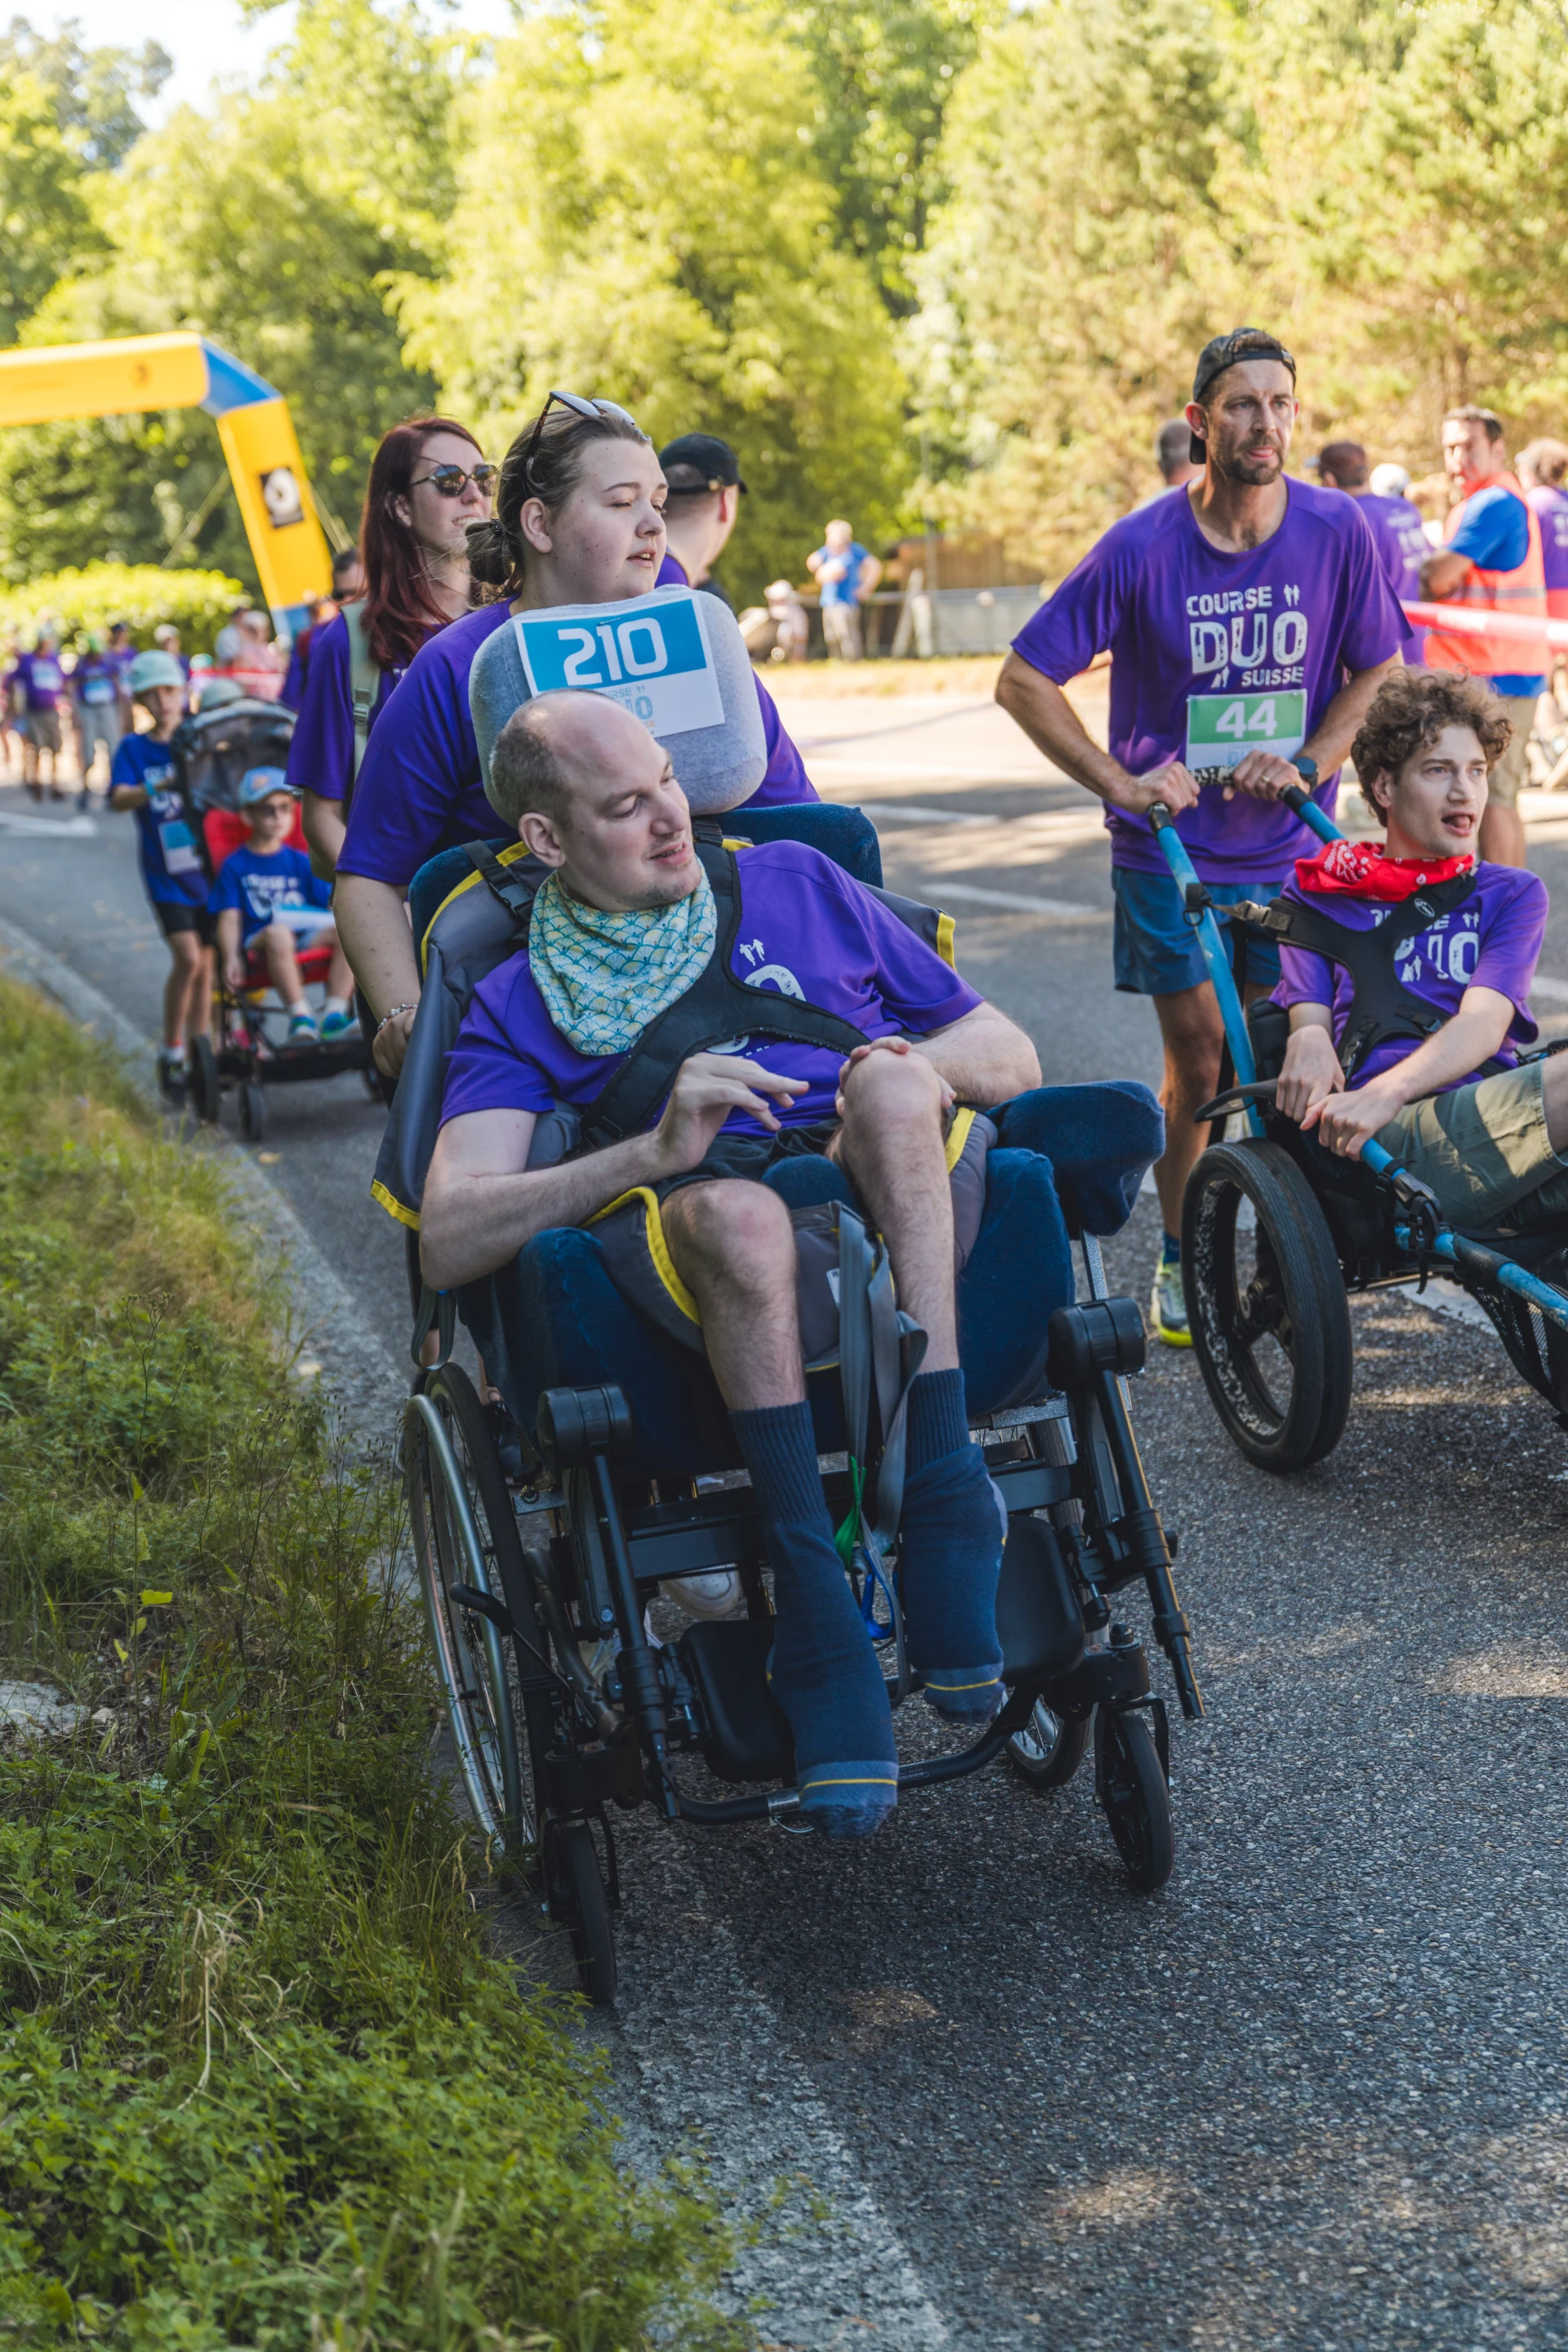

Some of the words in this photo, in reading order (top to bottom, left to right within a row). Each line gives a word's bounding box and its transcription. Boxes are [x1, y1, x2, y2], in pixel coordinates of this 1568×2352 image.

[1186, 586, 1272, 617] COURSE
[557, 617, 668, 686] 210
[1190, 611, 1308, 675] DUO
[1241, 666, 1304, 688] SUISSE
[1216, 699, 1277, 738] 44
